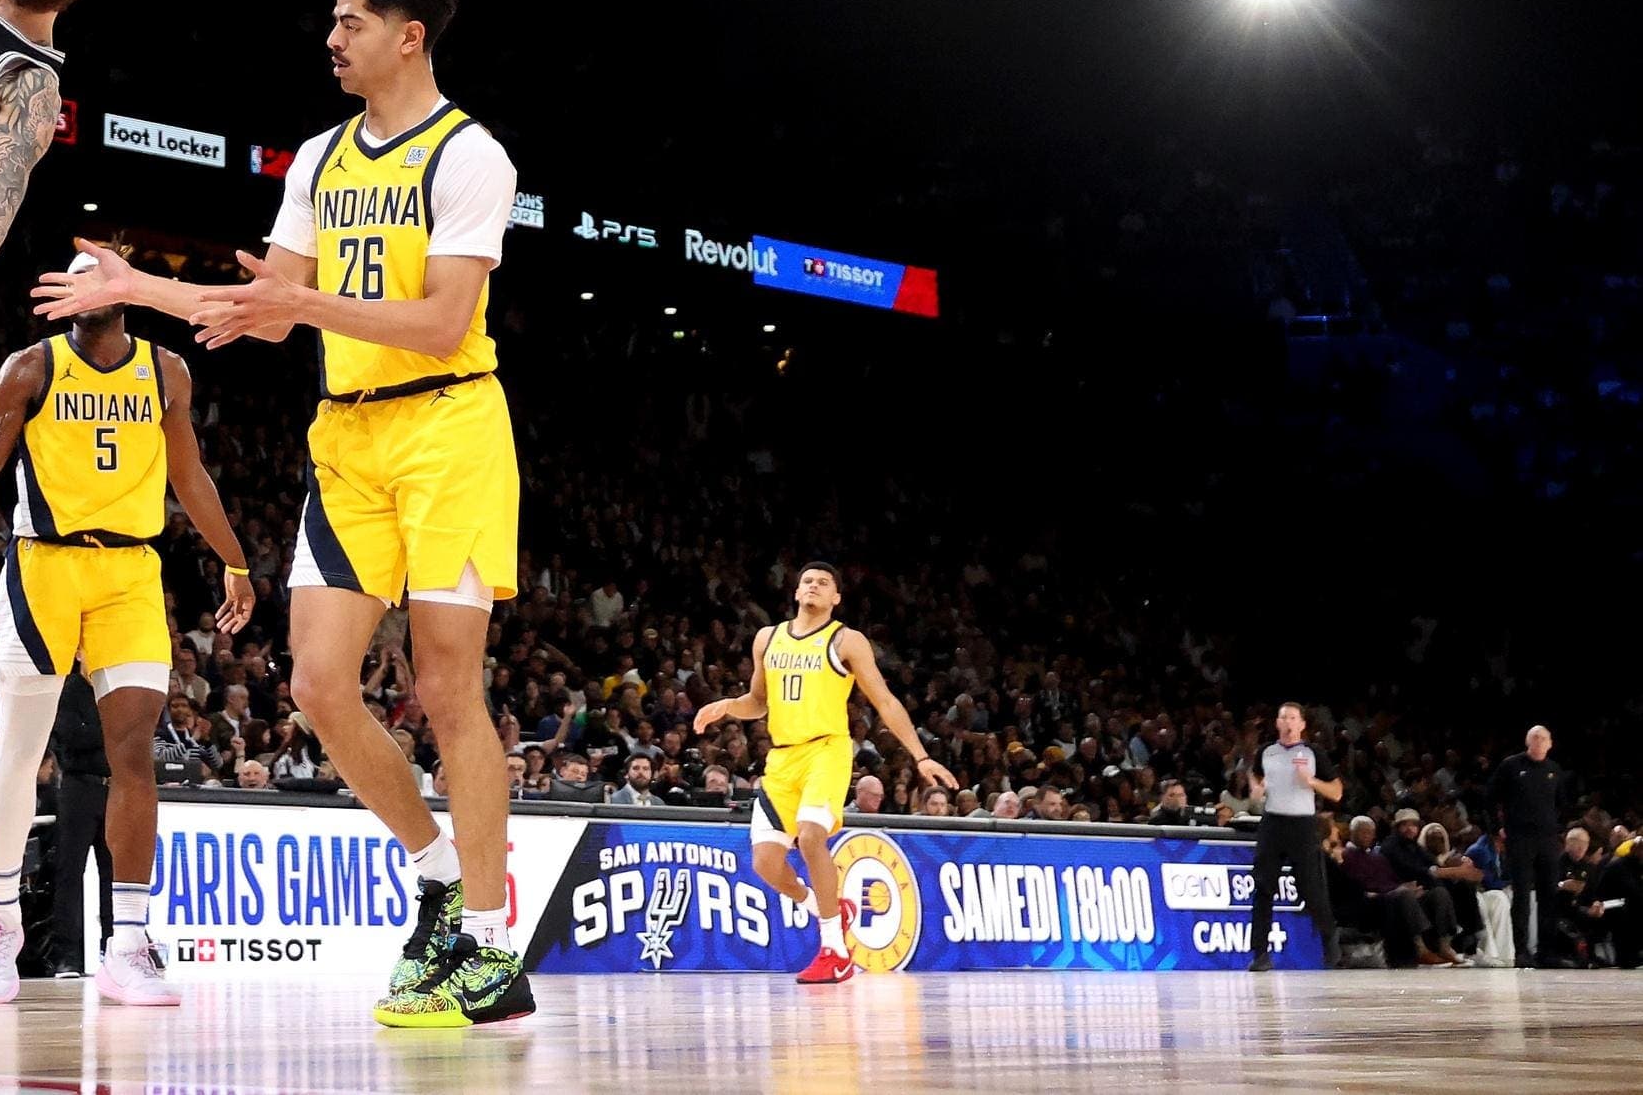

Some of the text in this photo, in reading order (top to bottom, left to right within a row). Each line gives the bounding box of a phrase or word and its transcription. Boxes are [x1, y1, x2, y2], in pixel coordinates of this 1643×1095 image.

[110, 121, 220, 159] Foot Locker
[318, 186, 420, 231] INDIANA
[510, 208, 539, 223] ORT
[602, 220, 656, 247] PS5
[338, 236, 384, 300] 26
[685, 228, 778, 277] Revolut
[826, 261, 885, 286] TISSOT
[55, 392, 153, 423] INDIANA
[96, 427, 118, 471] 5
[767, 653, 822, 670] INDIANA
[782, 674, 802, 701] 10
[599, 841, 737, 873] SAN ANTONIO
[277, 833, 408, 927] GAMES
[1232, 874, 1299, 901] SPTS
[572, 868, 771, 969] SPURS
[939, 862, 1155, 944] SAMEDI 18h00
[220, 938, 322, 962] TISSOT
[1193, 920, 1287, 953] CAN+
